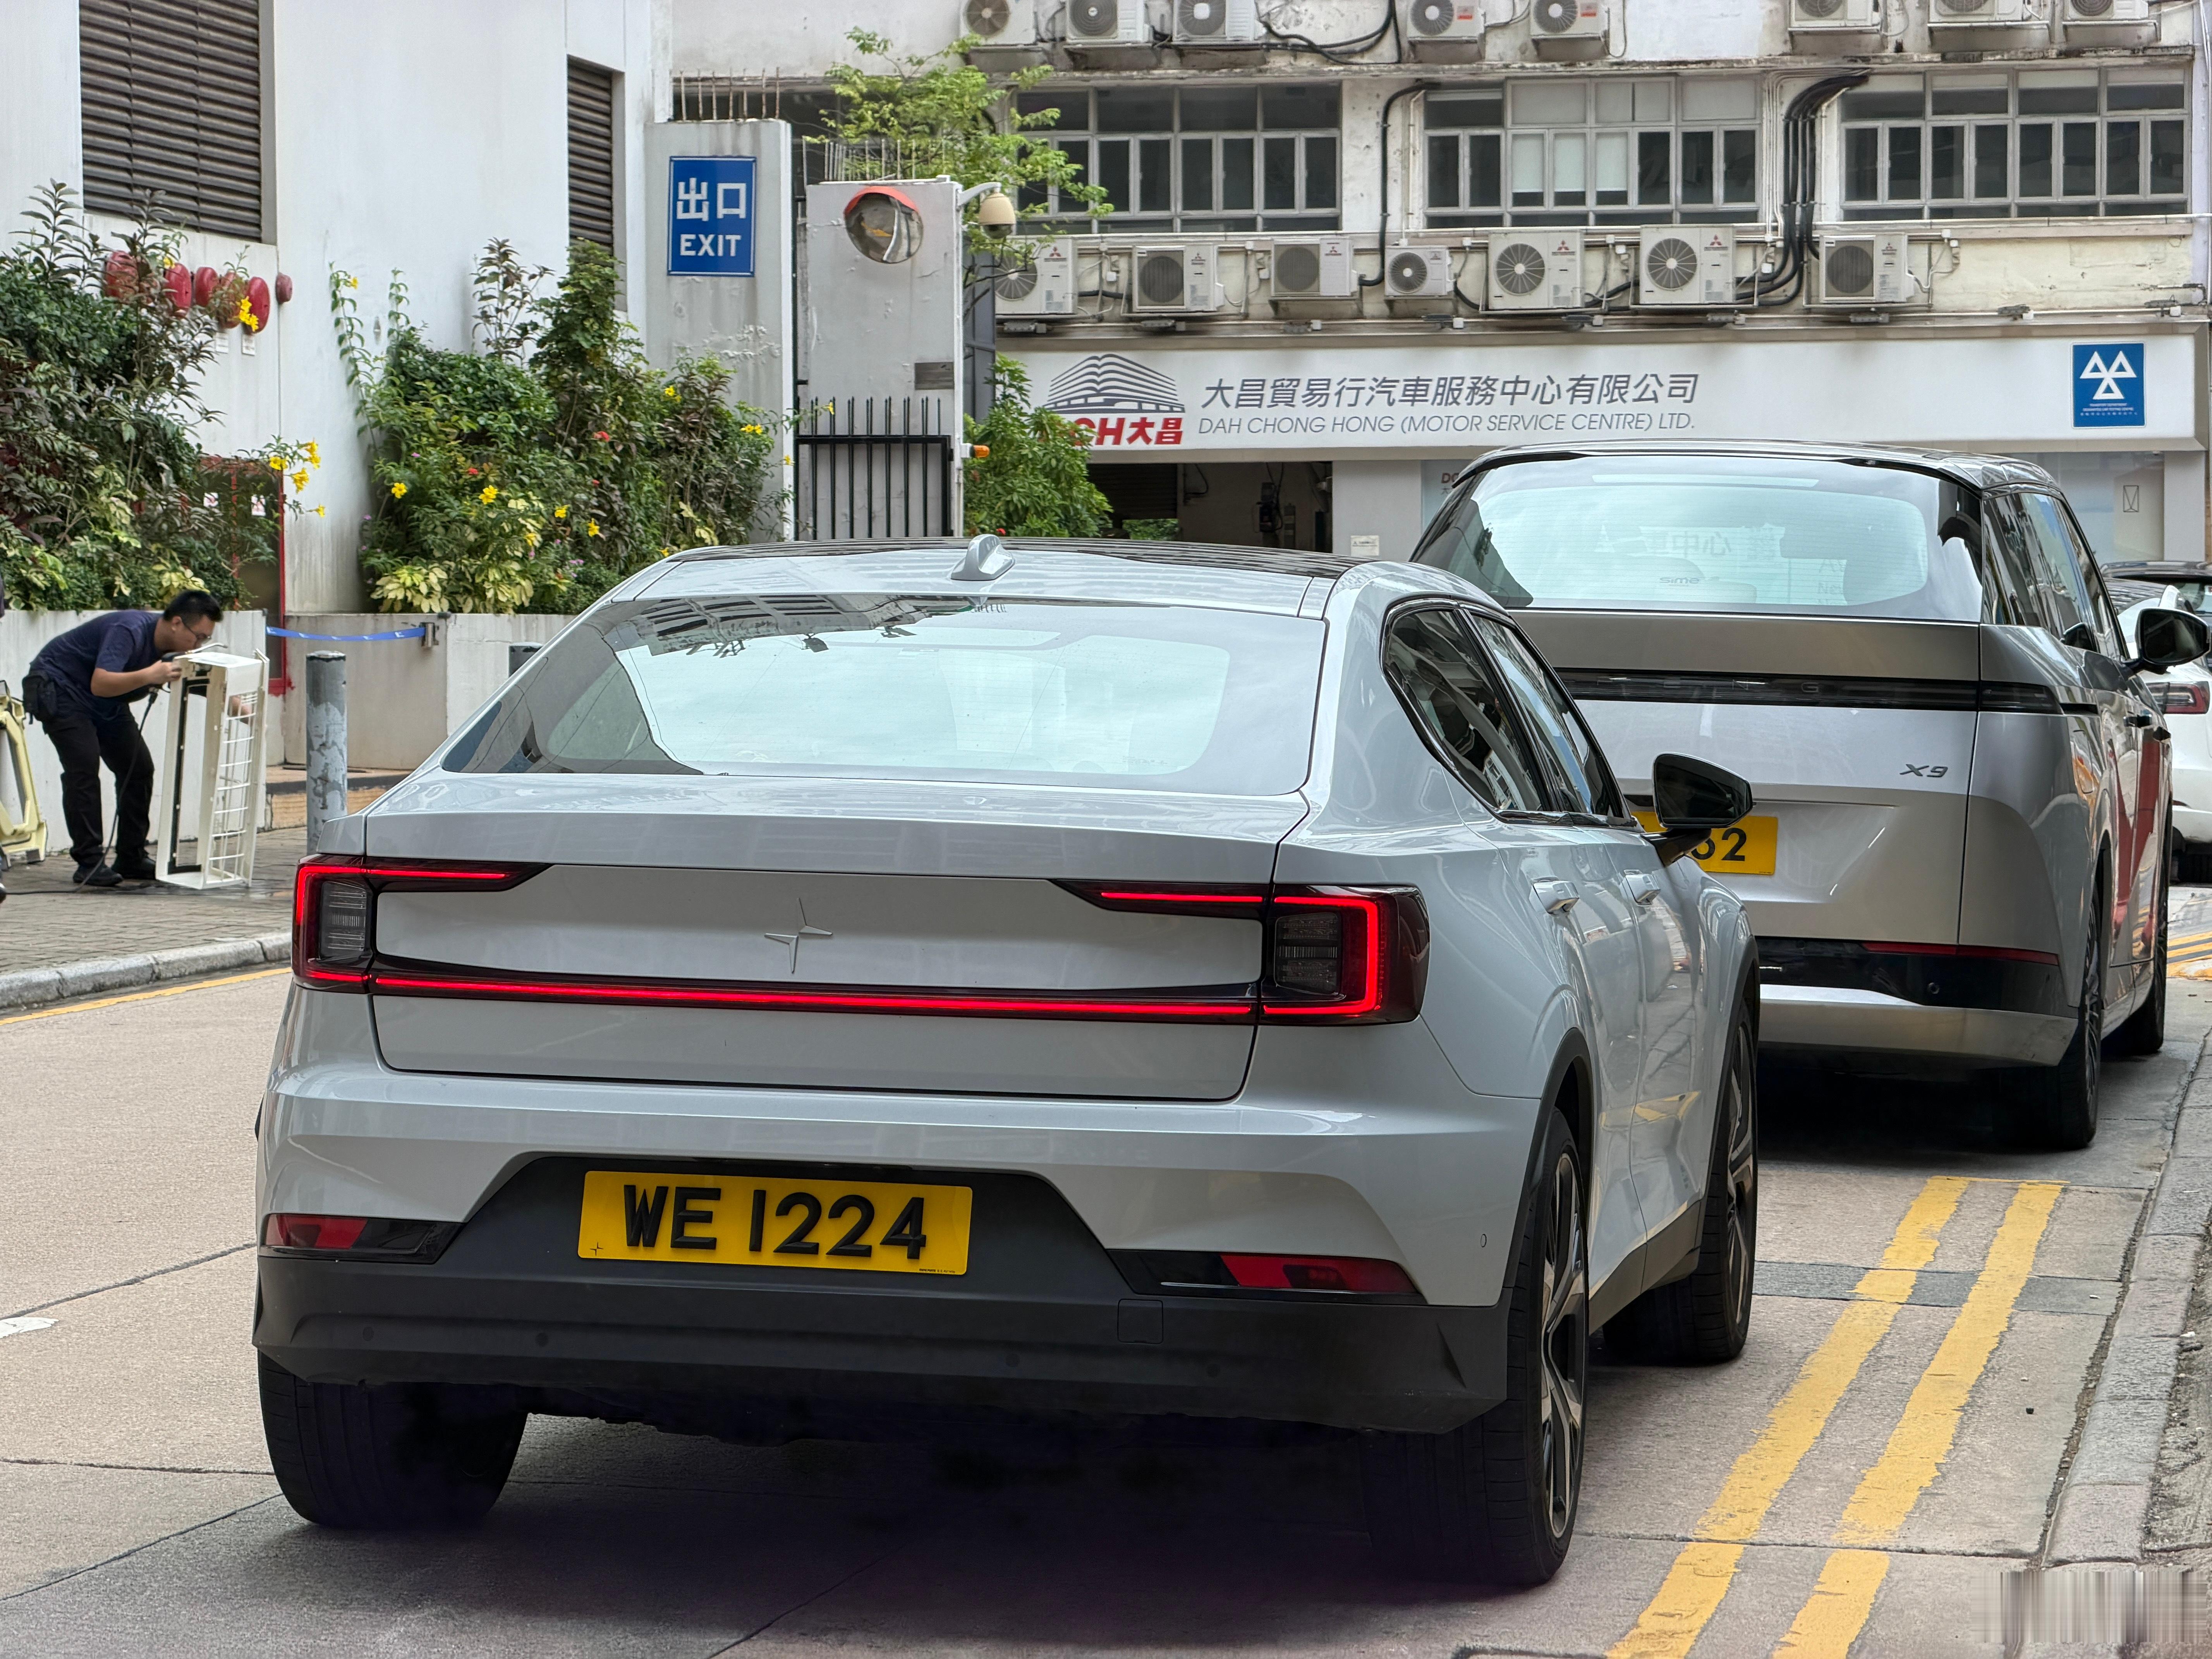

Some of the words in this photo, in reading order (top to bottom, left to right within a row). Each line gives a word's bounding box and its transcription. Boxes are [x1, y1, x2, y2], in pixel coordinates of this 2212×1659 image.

[676, 177, 747, 222] 出口
[680, 234, 742, 257] EXIT
[1201, 374, 1698, 409] 大昌貿易行汽車服務中心有限公司
[1199, 418, 1242, 434] DAH
[1247, 417, 1326, 433] CHONG
[1331, 416, 1395, 433] HONG
[1401, 415, 1482, 434] (MOTOR
[1487, 414, 1567, 431] SERVICE
[1571, 413, 1652, 431] CENTRE)
[1659, 413, 1695, 429] LTD.
[1899, 764, 1948, 778] X9
[623, 1184, 721, 1250] WE
[749, 1189, 927, 1260] 1224
